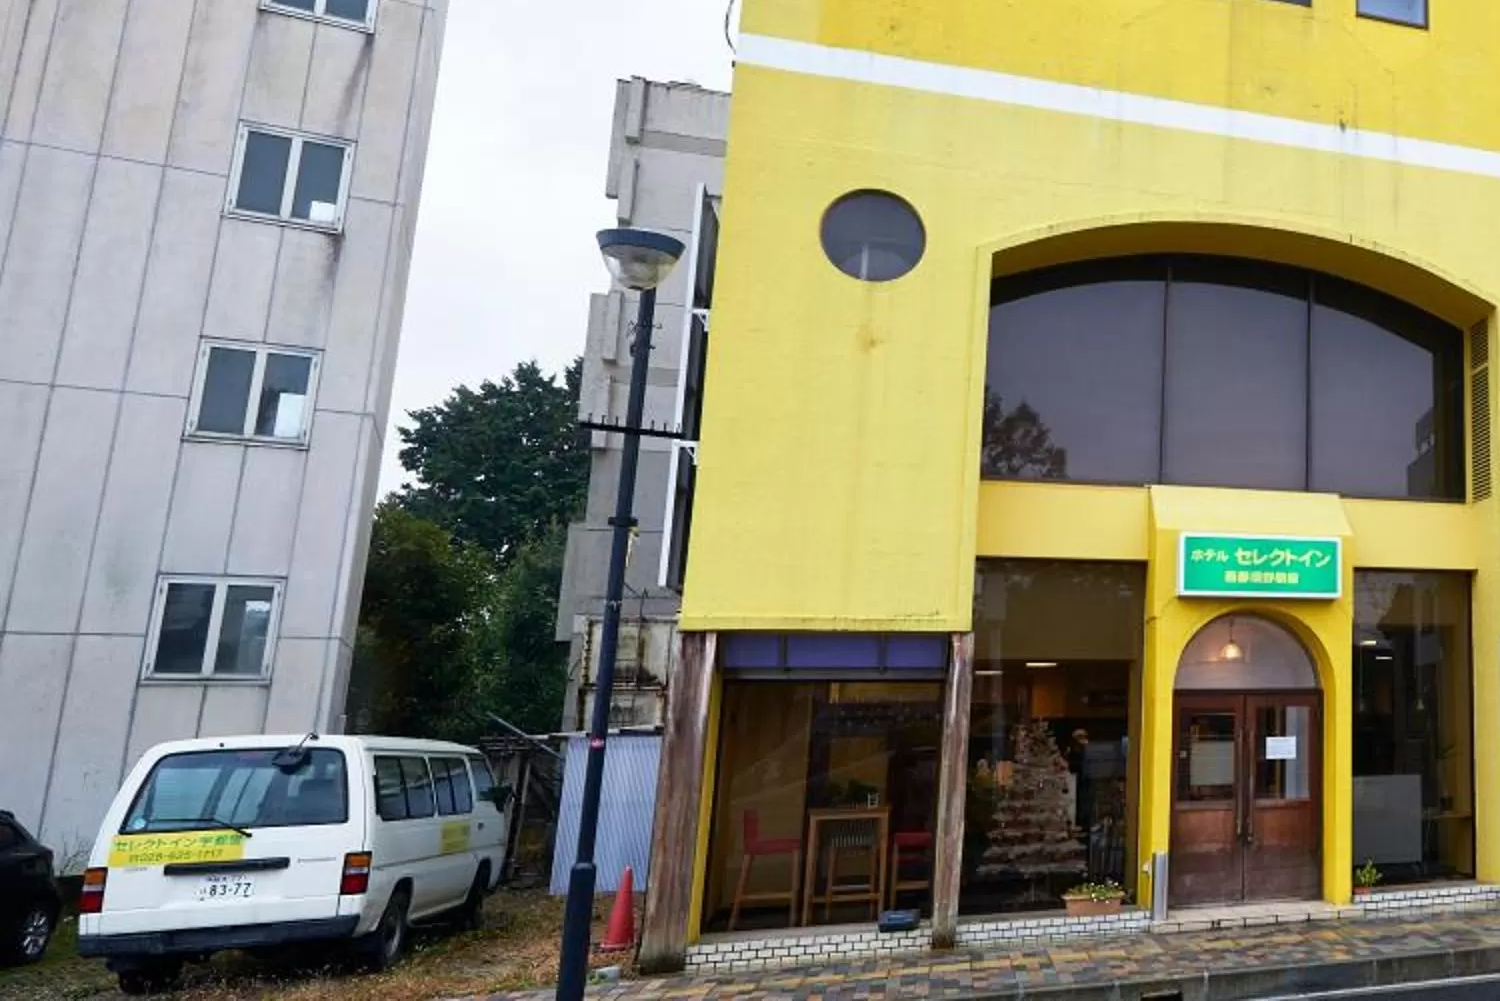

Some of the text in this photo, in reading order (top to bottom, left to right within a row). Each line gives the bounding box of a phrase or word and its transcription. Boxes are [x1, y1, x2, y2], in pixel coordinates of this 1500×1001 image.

[1191, 546, 1331, 567] ホテル セレクトイン
